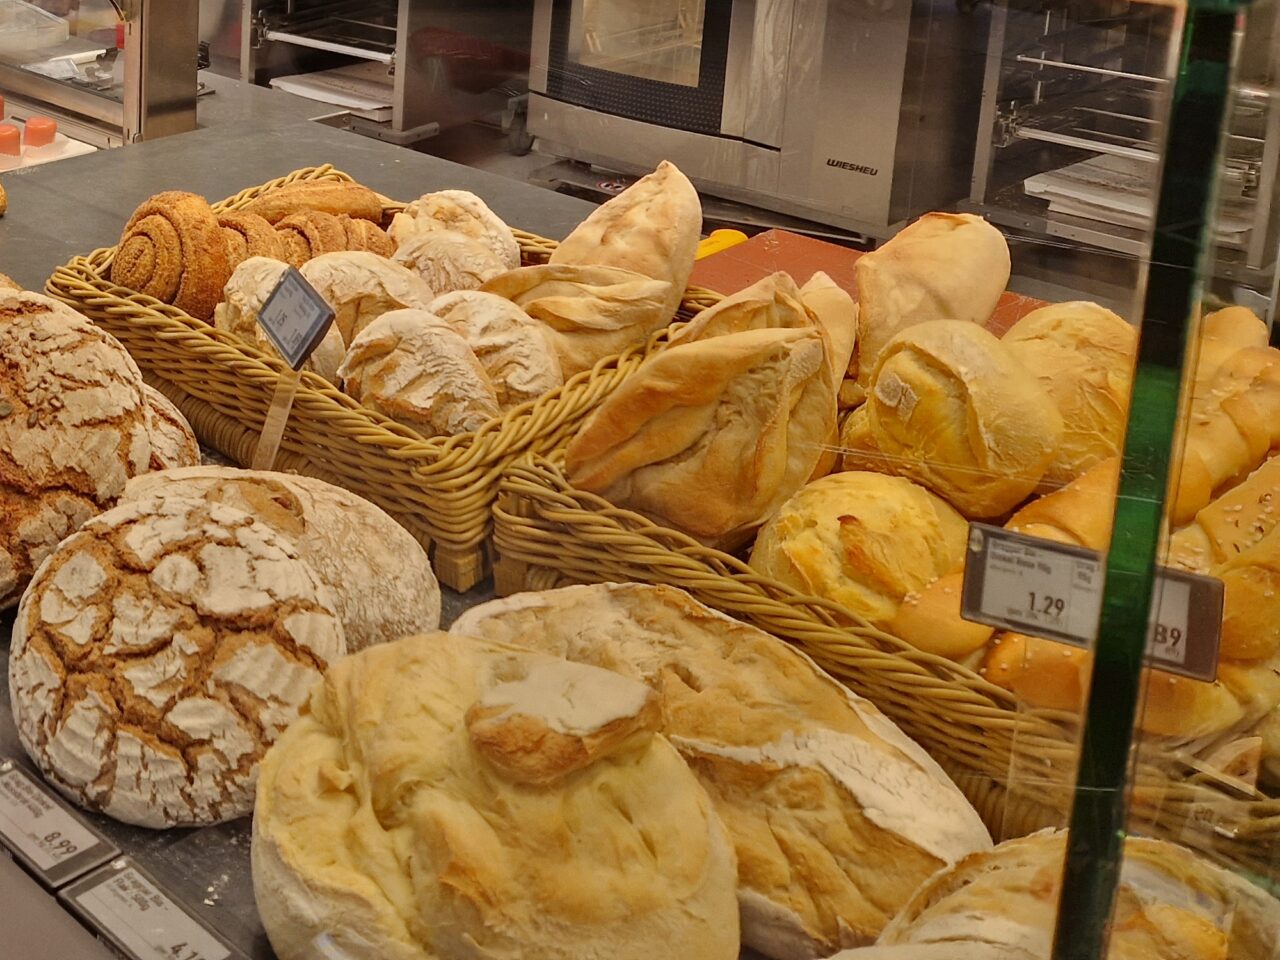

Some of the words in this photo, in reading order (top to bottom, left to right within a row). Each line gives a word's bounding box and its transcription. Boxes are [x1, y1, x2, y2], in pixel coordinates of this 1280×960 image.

[826, 158, 878, 176] WIESHEU
[1028, 591, 1065, 617] 1.29
[43, 831, 78, 856] 8.99
